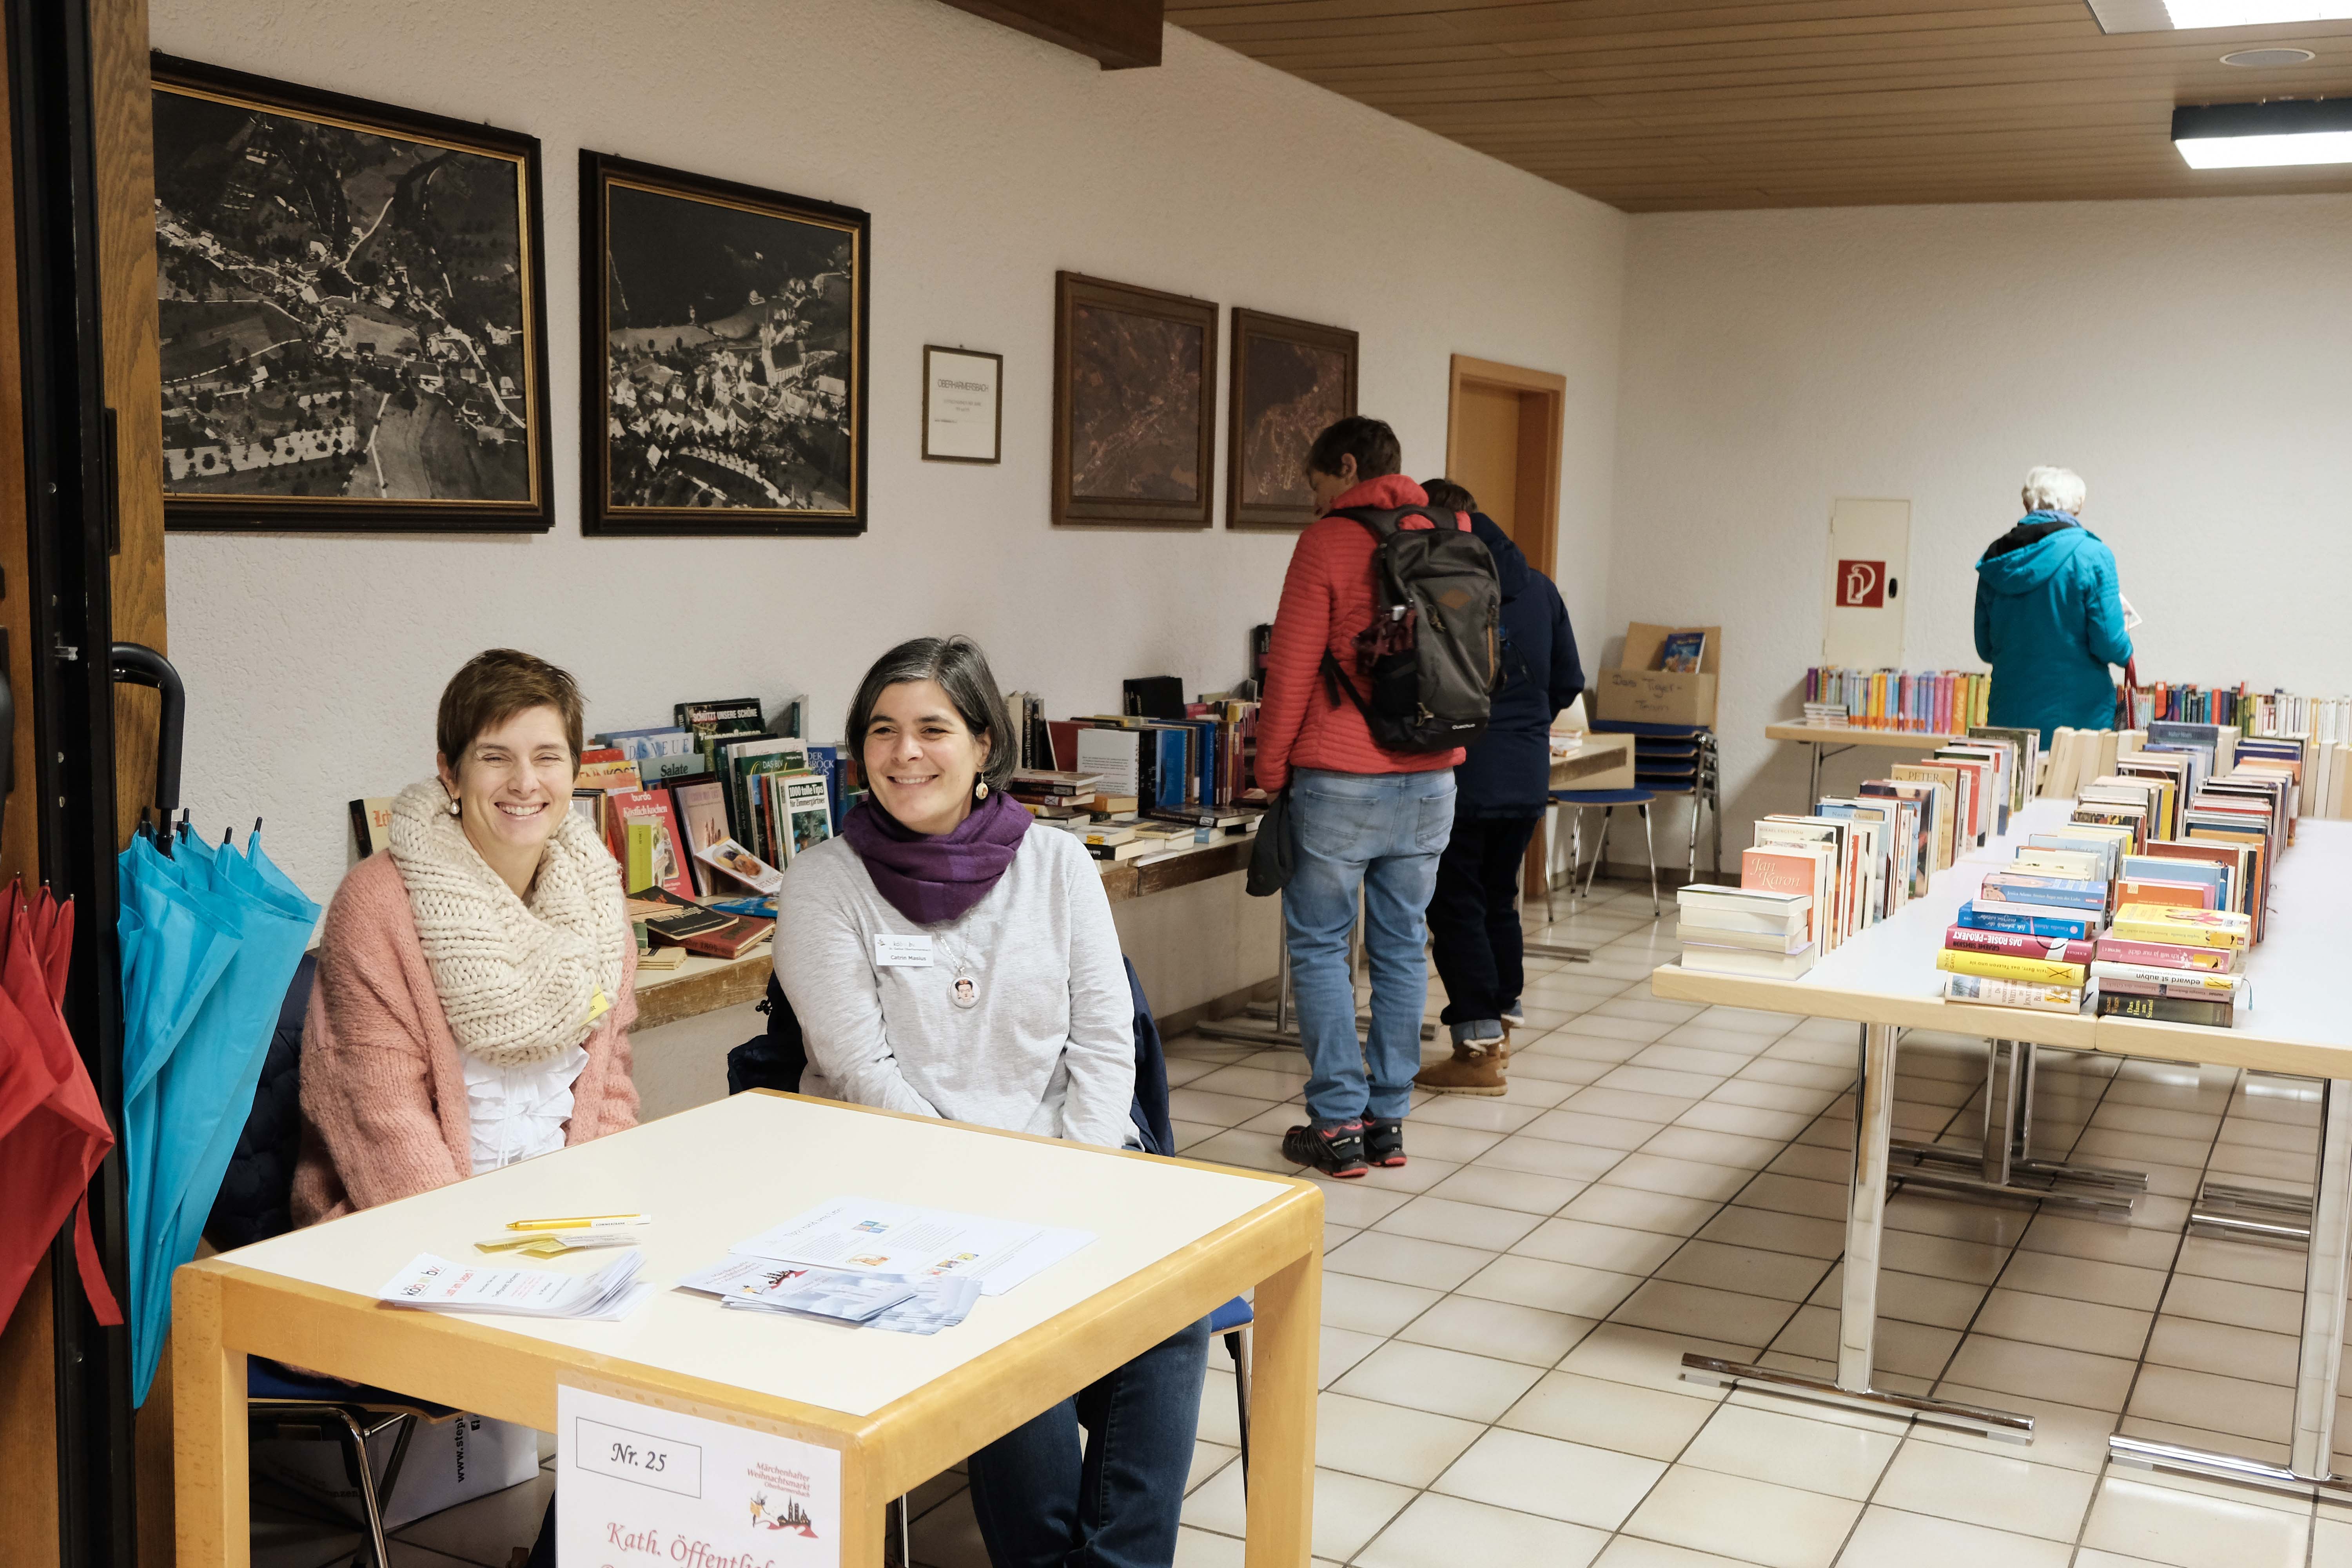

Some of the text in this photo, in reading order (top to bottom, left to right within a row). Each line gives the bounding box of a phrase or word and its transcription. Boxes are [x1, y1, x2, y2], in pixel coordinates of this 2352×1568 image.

[651, 739, 689, 757] NEUE
[661, 764, 688, 777] Salate
[1909, 771, 1940, 782] PETER
[631, 791, 652, 802] burda
[789, 784, 824, 797] 1000 tolle Tips
[796, 797, 825, 807] Zimmergärtner
[647, 804, 668, 814] kochen
[1750, 858, 1775, 876] Jan
[1760, 872, 1800, 889] Karon
[1953, 931, 2023, 947] DAS ROSIE-PROJEKT
[1976, 943, 2000, 951] GRAEME
[2136, 973, 2159, 982] aubyn
[2171, 976, 2200, 986] edward
[2142, 1004, 2147, 1013] am
[610, 1443, 667, 1472] Nr. 25
[756, 1461, 810, 1482] Märchenhafter
[747, 1468, 810, 1491] Weihnachtsmarkt
[764, 1481, 810, 1498] Oberharmersbach
[607, 1522, 661, 1556] Kath.
